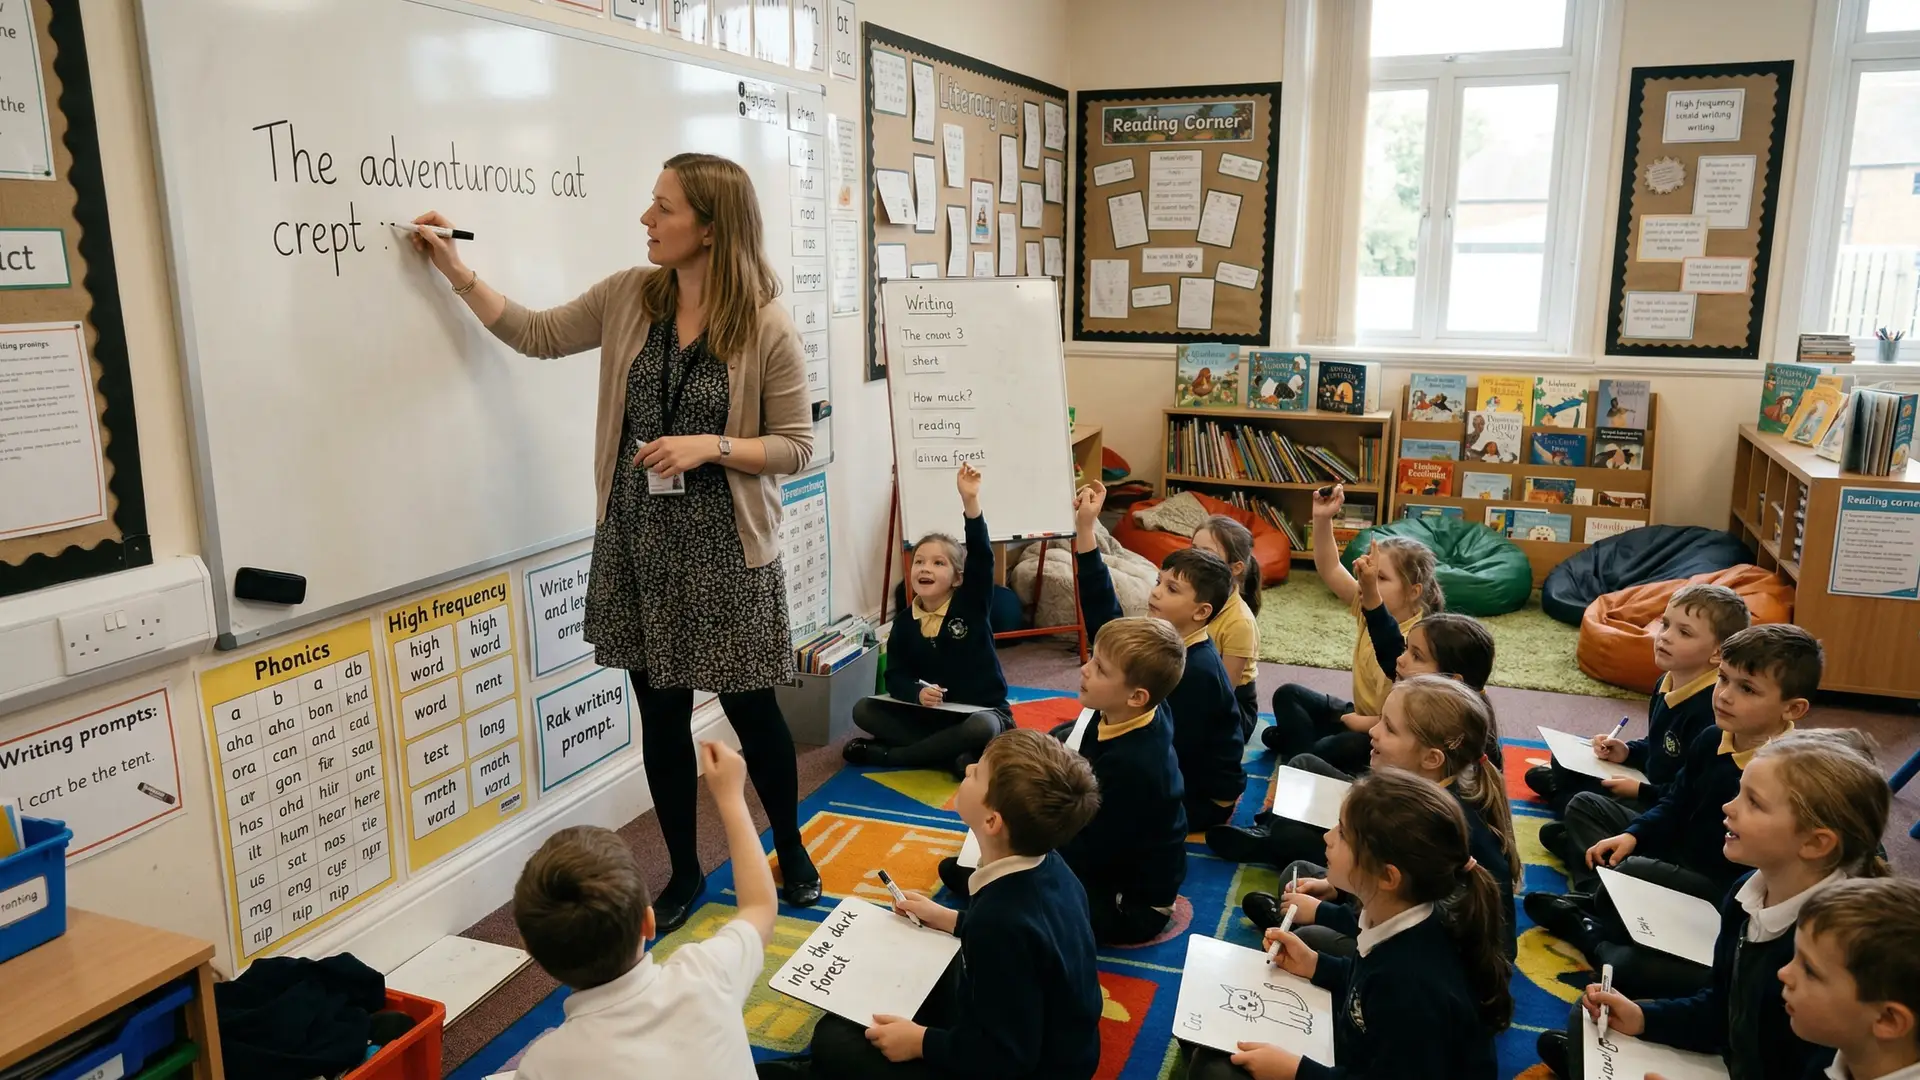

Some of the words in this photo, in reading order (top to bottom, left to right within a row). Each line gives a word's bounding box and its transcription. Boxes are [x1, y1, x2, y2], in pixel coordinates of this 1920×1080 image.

[938, 73, 998, 132] Literacy
[1113, 115, 1178, 134] Reading
[1184, 114, 1243, 131] Corner
[253, 119, 337, 186] The
[360, 135, 537, 196] adventurous
[550, 156, 588, 199] cat
[273, 201, 366, 277] crept
[905, 294, 954, 318] Writing
[902, 328, 921, 341] The
[956, 327, 964, 340] 3
[913, 391, 932, 402] How
[918, 419, 961, 435] reading
[952, 449, 985, 466] forest
[540, 577, 573, 598] Write
[388, 607, 429, 634] High
[432, 582, 507, 616] frequency
[545, 598, 567, 620] and
[470, 614, 497, 637] high
[410, 635, 440, 658] high
[470, 636, 501, 659] word
[254, 643, 331, 681] Phonics
[410, 659, 445, 682] word
[231, 708, 241, 721] a
[273, 690, 283, 706] b
[314, 678, 324, 691] a
[344, 661, 362, 679] db
[475, 673, 503, 695] nent
[414, 696, 448, 721] word
[546, 711, 571, 732] Rak
[575, 685, 622, 716] writing
[0, 735, 73, 770] Writing
[79, 705, 158, 748] prompts:
[226, 733, 254, 752] aha
[268, 717, 296, 736] aha
[479, 716, 506, 739] long
[562, 715, 615, 757] prompt.
[232, 762, 257, 780] ora
[272, 745, 298, 763] can
[312, 726, 337, 747] and
[424, 744, 450, 765] test
[67, 773, 88, 793] be
[91, 761, 117, 783] the
[121, 751, 155, 776] tent.
[275, 771, 302, 794] gon
[239, 816, 264, 836] has
[280, 824, 309, 846] hum
[318, 805, 347, 827] hear
[354, 789, 381, 809] here
[250, 872, 265, 889] us
[287, 851, 308, 870] sat
[287, 877, 312, 897] eng
[329, 884, 350, 902] nip
[808, 940, 834, 960] the
[828, 910, 858, 938] dark
[810, 955, 851, 996] forest
